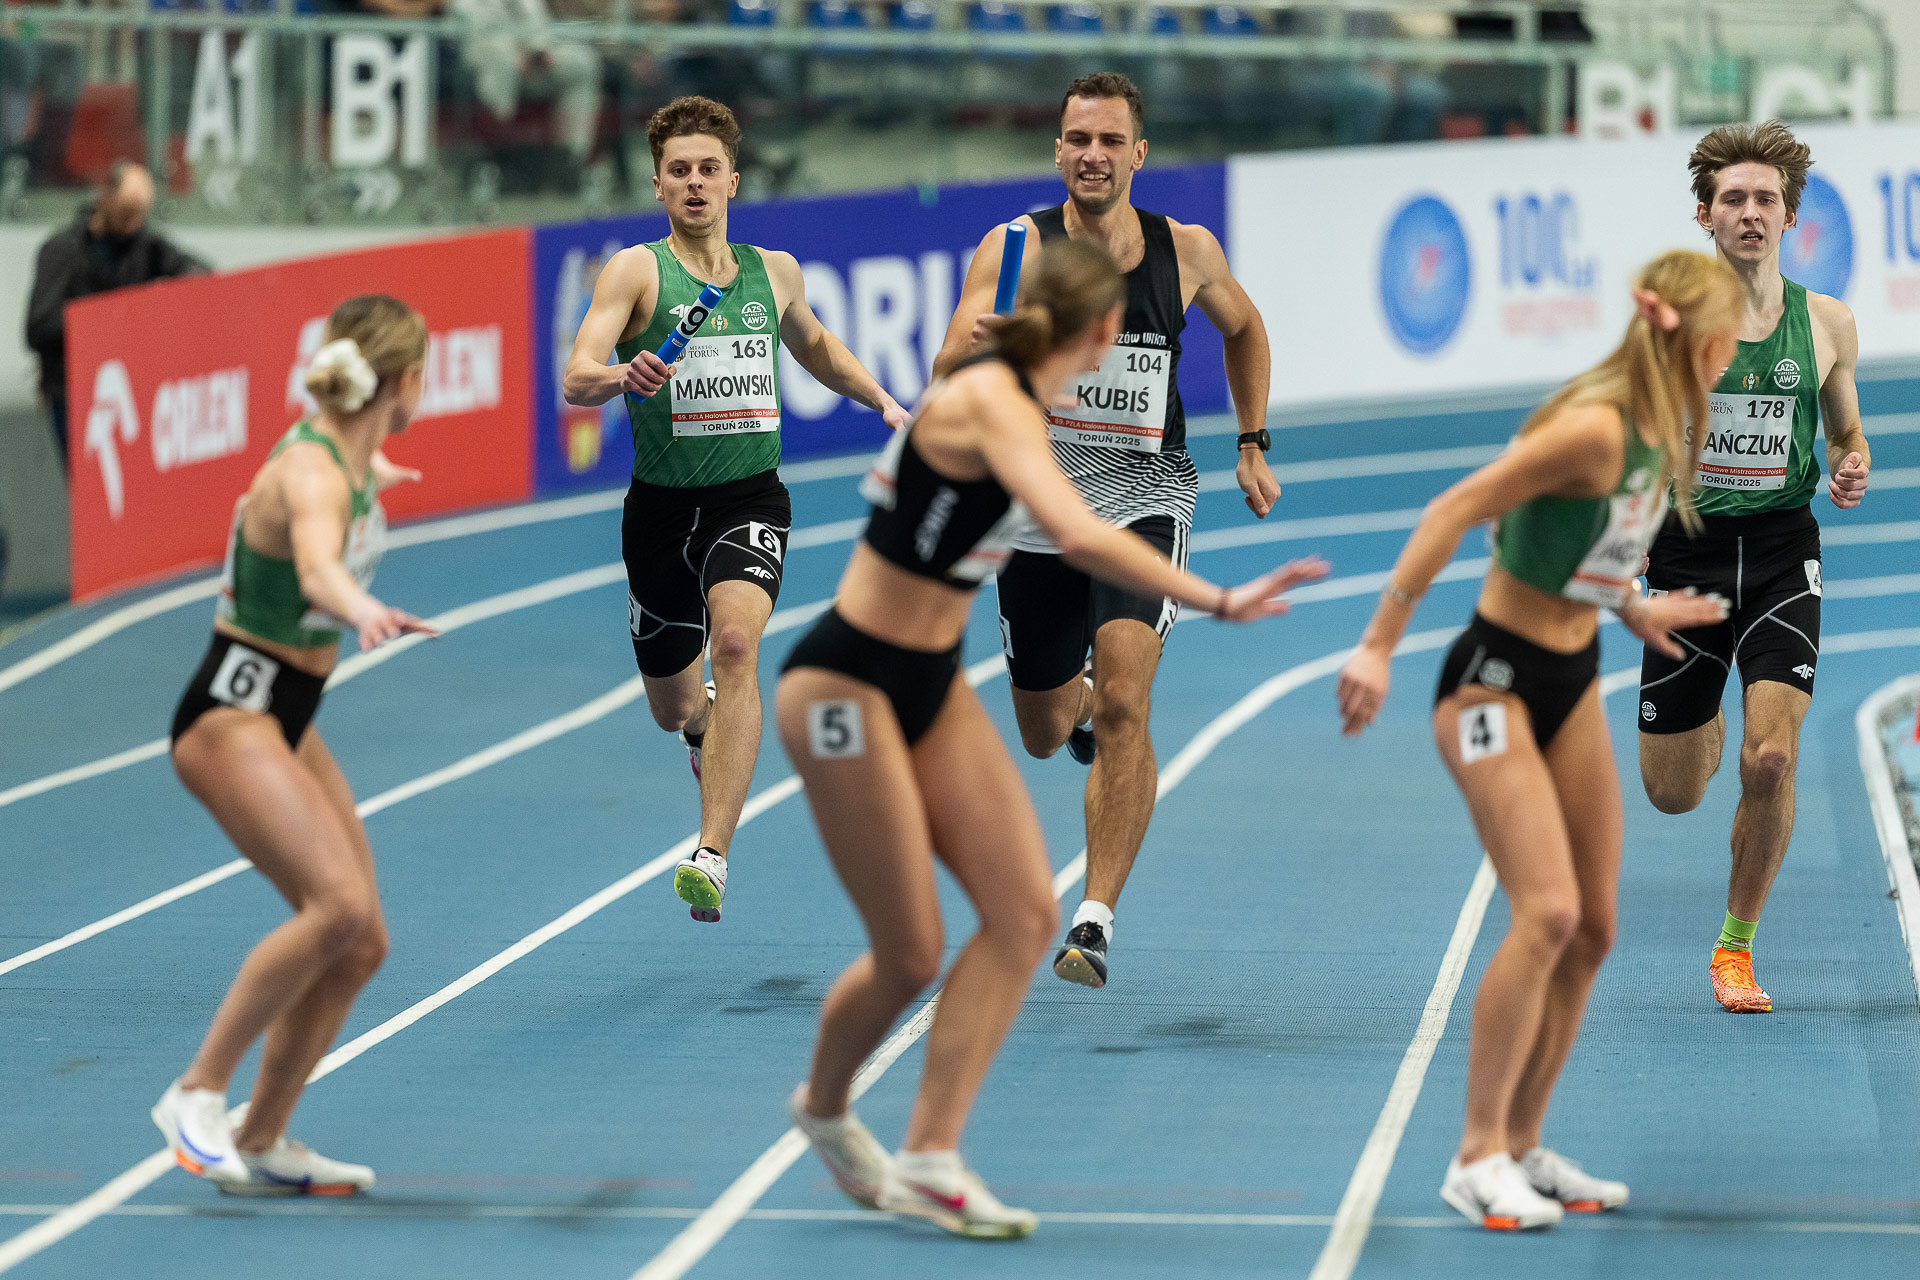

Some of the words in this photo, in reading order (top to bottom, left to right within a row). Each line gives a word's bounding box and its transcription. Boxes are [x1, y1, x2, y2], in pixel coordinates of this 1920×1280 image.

[183, 27, 256, 166] A1
[333, 34, 429, 170] B1
[746, 305, 762, 313] AZS
[747, 316, 764, 325] AWF
[688, 347, 720, 359] TORUŃ
[732, 339, 767, 359] 163
[1126, 352, 1162, 375] 104
[1780, 363, 1795, 372] AZS
[675, 375, 773, 401] MAKOWSKI
[1779, 375, 1798, 384] AWF
[1076, 385, 1149, 413] KUBIŚ
[688, 413, 704, 421] PZLA
[704, 412, 728, 420] Halowe
[729, 410, 763, 418] Mistrzostwa
[1747, 399, 1785, 419] 178
[702, 420, 736, 432] TORUŃ
[738, 420, 761, 430] 2025
[1065, 419, 1081, 428] PZLA
[1081, 423, 1107, 431] Halowe
[1107, 424, 1147, 435] Mistrzostwa
[1077, 432, 1113, 444] TORUŃ
[1115, 436, 1141, 447] 2025
[1684, 425, 1788, 456] SAŃCZUK
[1704, 466, 1729, 474] Halowe
[1729, 468, 1767, 476] Mistrzostwa
[1700, 475, 1735, 486] TORUŃ
[1737, 479, 1761, 487] 2025
[758, 528, 777, 554] 6
[743, 566, 775, 580] 4F
[230, 660, 262, 699] 6
[1791, 663, 1815, 680] 4F
[823, 706, 851, 752] 5
[1471, 706, 1493, 749] 4
